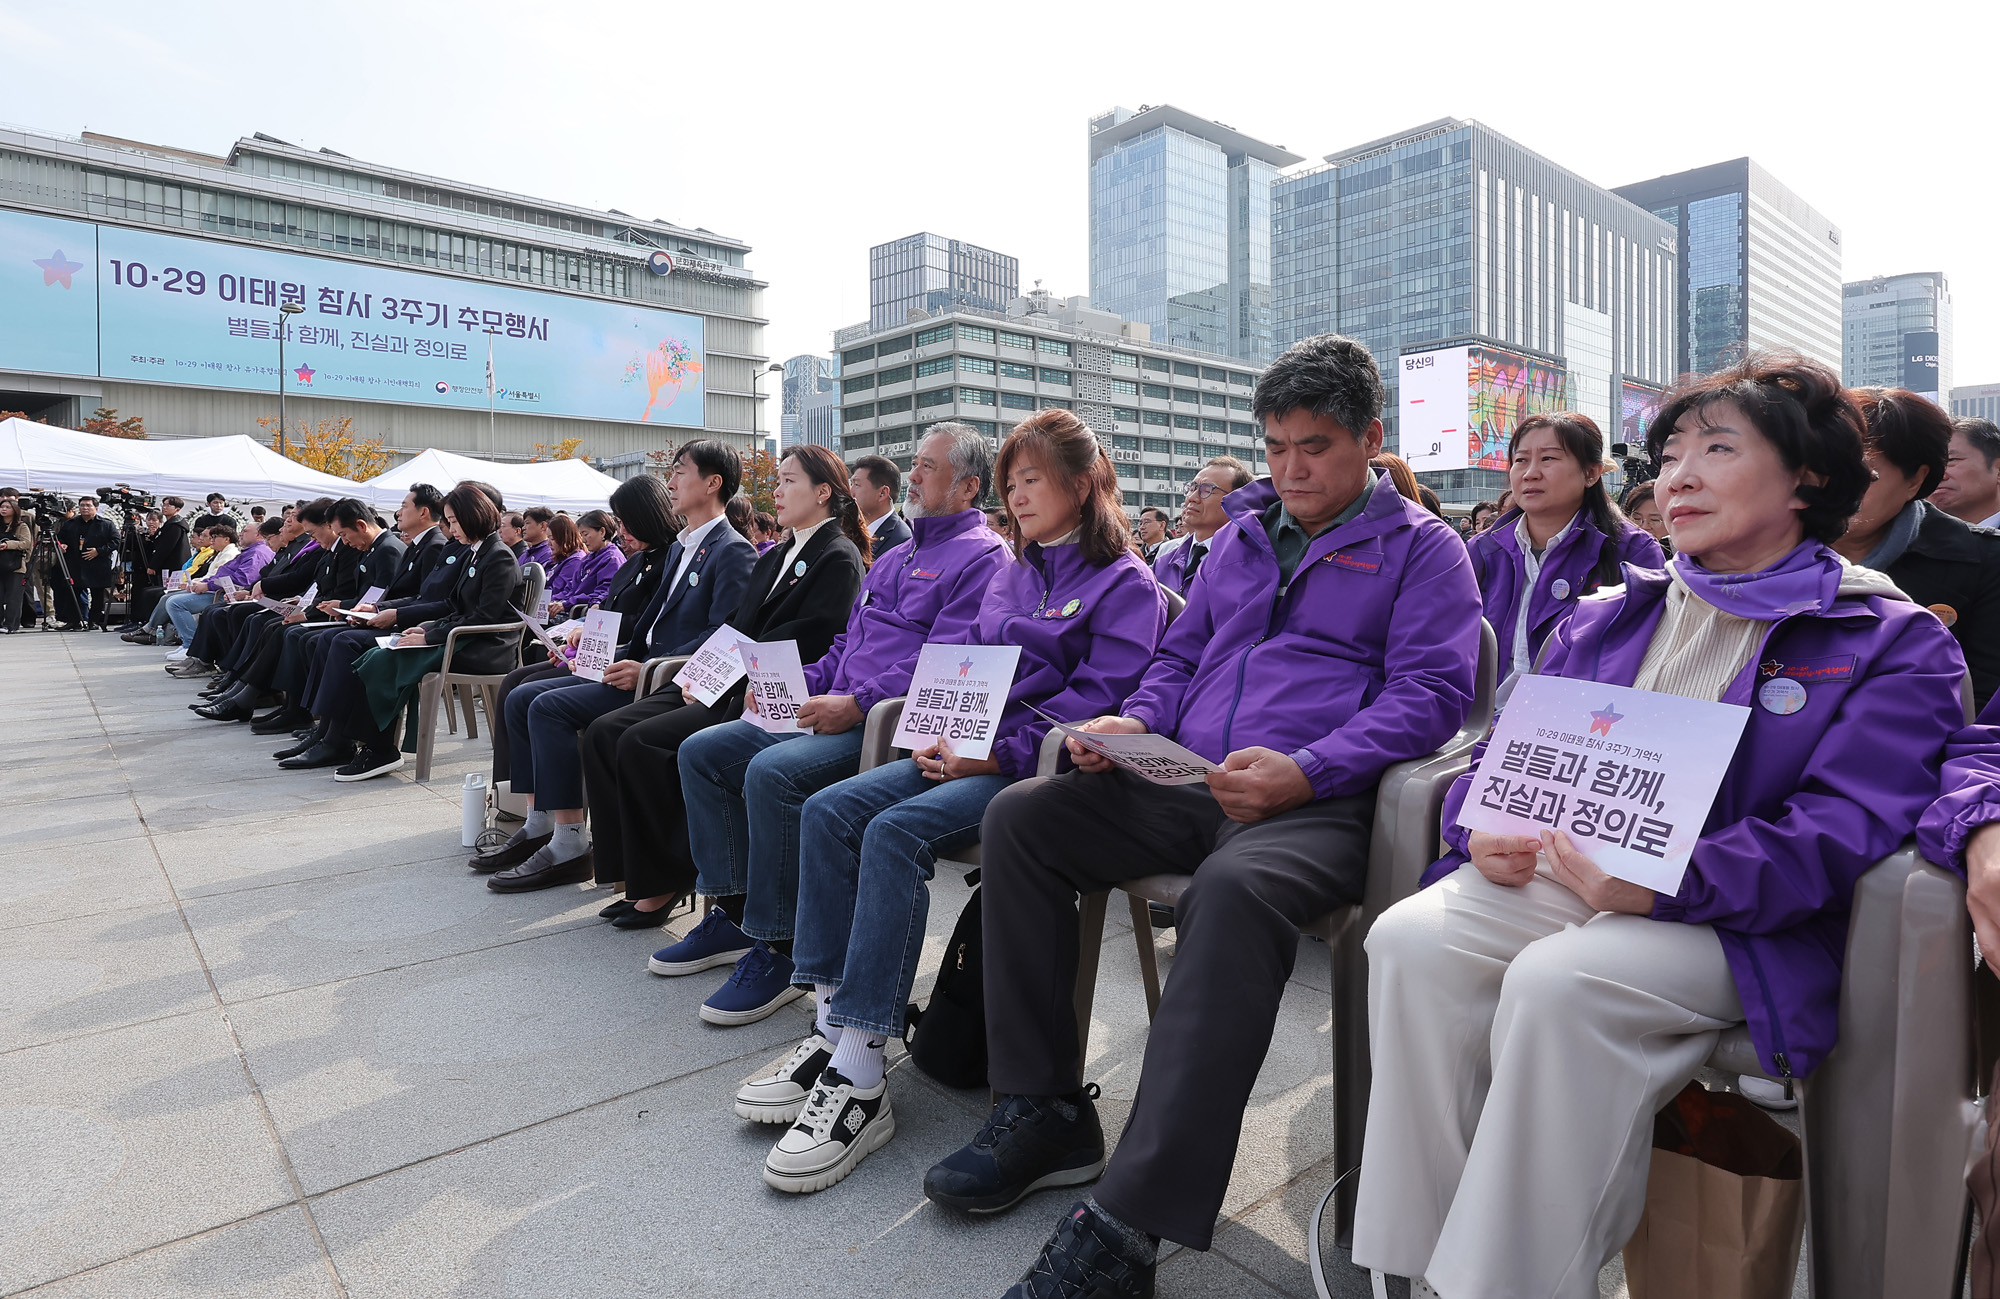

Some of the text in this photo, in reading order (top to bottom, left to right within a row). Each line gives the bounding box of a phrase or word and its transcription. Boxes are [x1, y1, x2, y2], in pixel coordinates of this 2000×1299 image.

[110, 259, 549, 341] 10·29 이태원 참사 3주기 추모행사
[228, 316, 468, 361] 별들과 함께, 진실과 정의로
[200, 361, 223, 372] 이태원
[226, 364, 241, 373] 참사
[1405, 355, 1434, 371] 당신의
[346, 374, 365, 385] 이태원
[368, 377, 381, 386] 참사
[383, 378, 421, 389] 시민대책회의
[451, 385, 484, 395] 행정안전부
[508, 390, 541, 400] 서울특별시
[1431, 441, 1441, 453] 이
[696, 649, 722, 670] 별들과
[682, 662, 726, 696] 진실과 정의로
[763, 681, 794, 702] 함께,
[915, 687, 989, 717] 별들과 함께,
[904, 711, 991, 741] 진실과 정의로
[1559, 732, 1586, 747] 이태원
[1585, 738, 1605, 751] 참사
[1605, 742, 1631, 757] 3주기
[1632, 748, 1663, 763] 기억식
[1500, 739, 1666, 814] 별들과 함께,
[1480, 775, 1675, 859] 진실과 정의로
